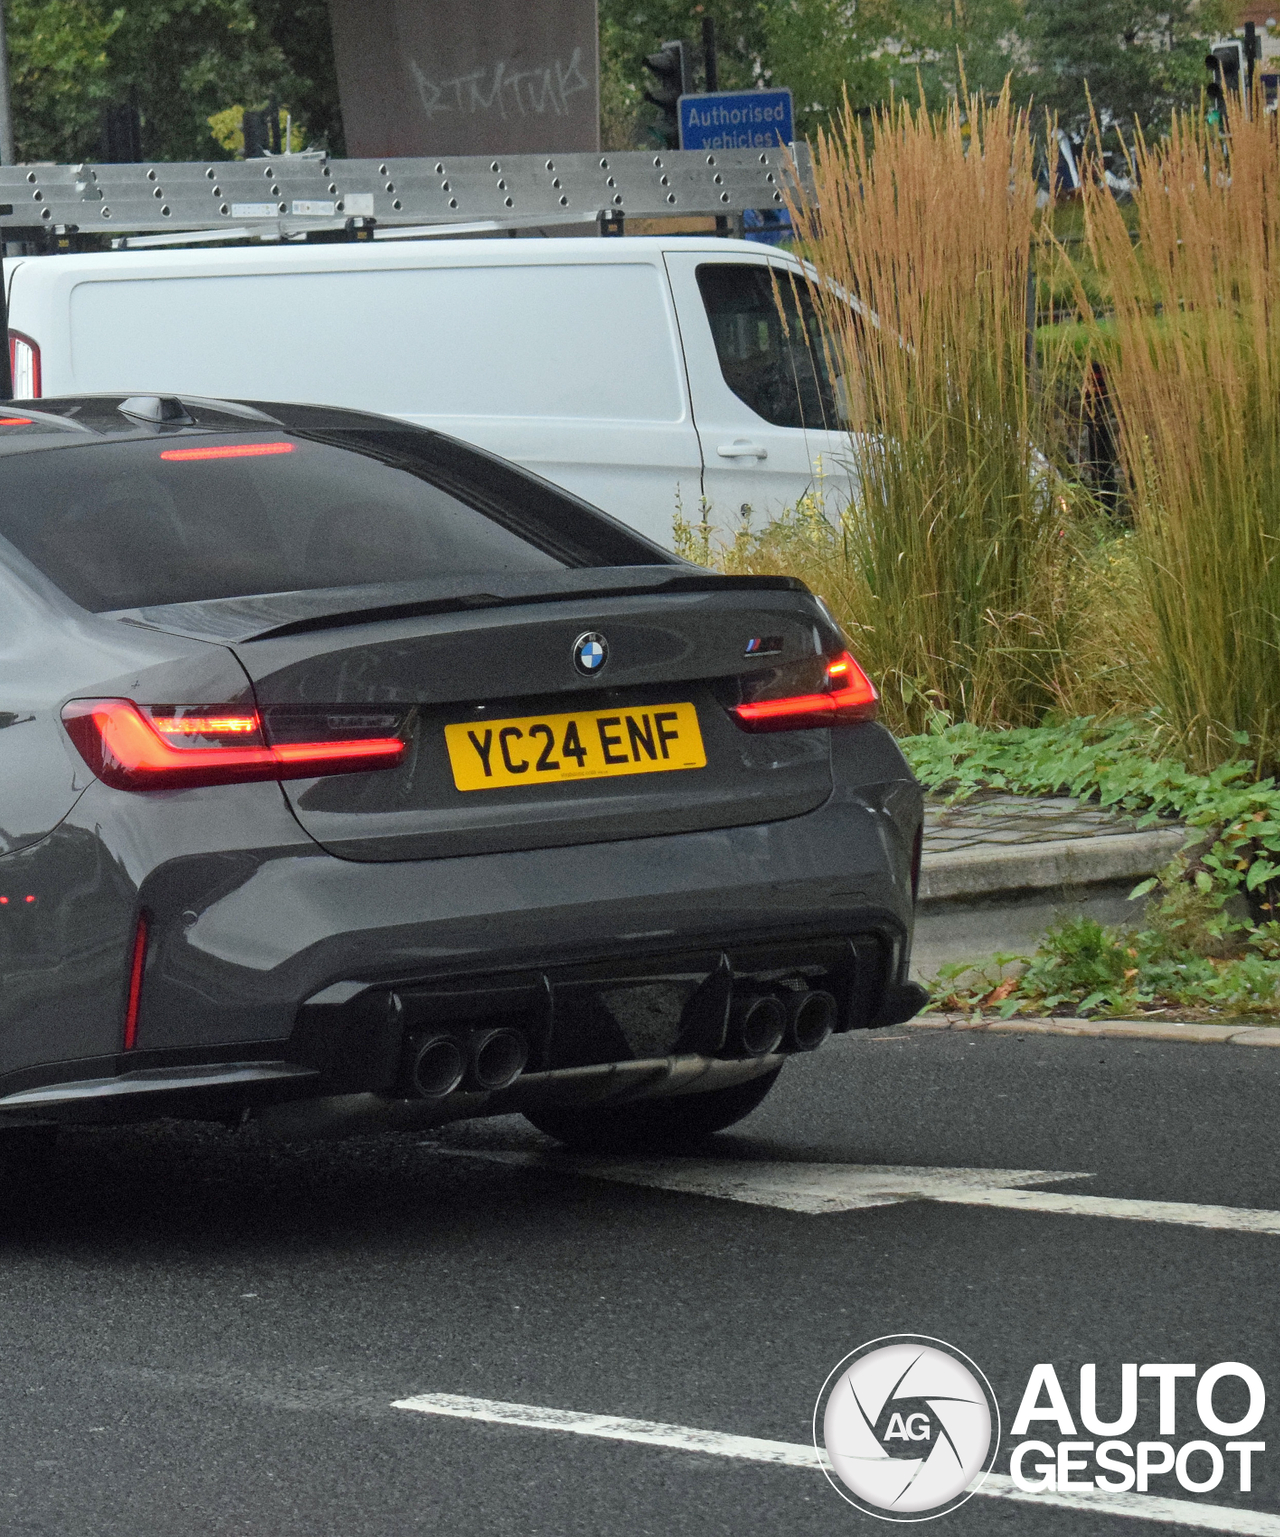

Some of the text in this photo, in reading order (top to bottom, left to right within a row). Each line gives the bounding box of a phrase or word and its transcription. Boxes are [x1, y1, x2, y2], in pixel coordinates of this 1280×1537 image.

[688, 101, 785, 128] Authorised
[702, 131, 773, 149] vehicles
[467, 711, 680, 777] YC24 ENF
